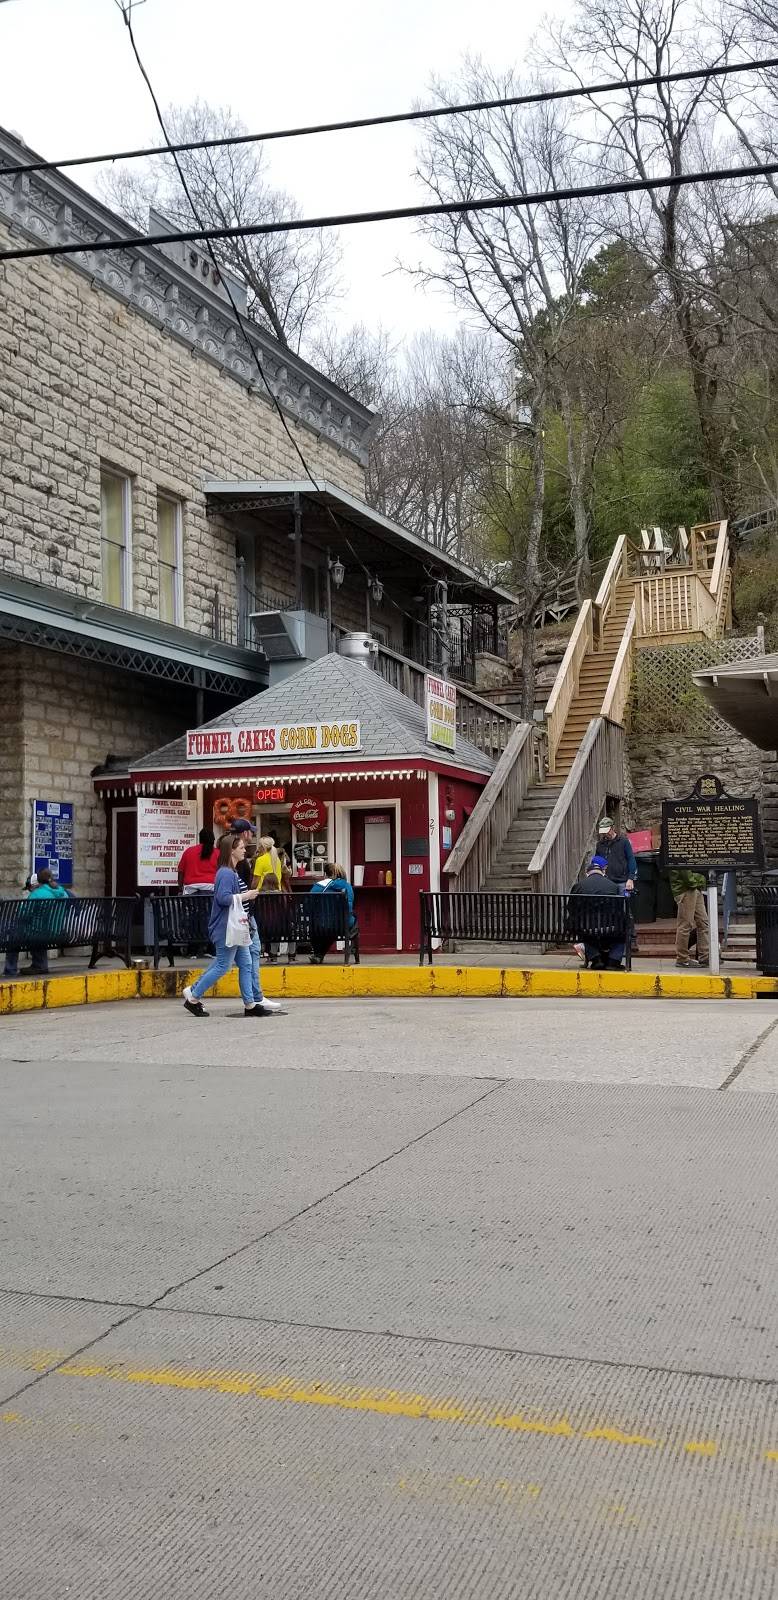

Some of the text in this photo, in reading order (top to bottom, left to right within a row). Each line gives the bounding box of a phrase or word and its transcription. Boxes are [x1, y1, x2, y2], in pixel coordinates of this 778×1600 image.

[188, 724, 358, 755] FUNNEL CAKES CORN DOGS
[257, 789, 284, 800] OPEN
